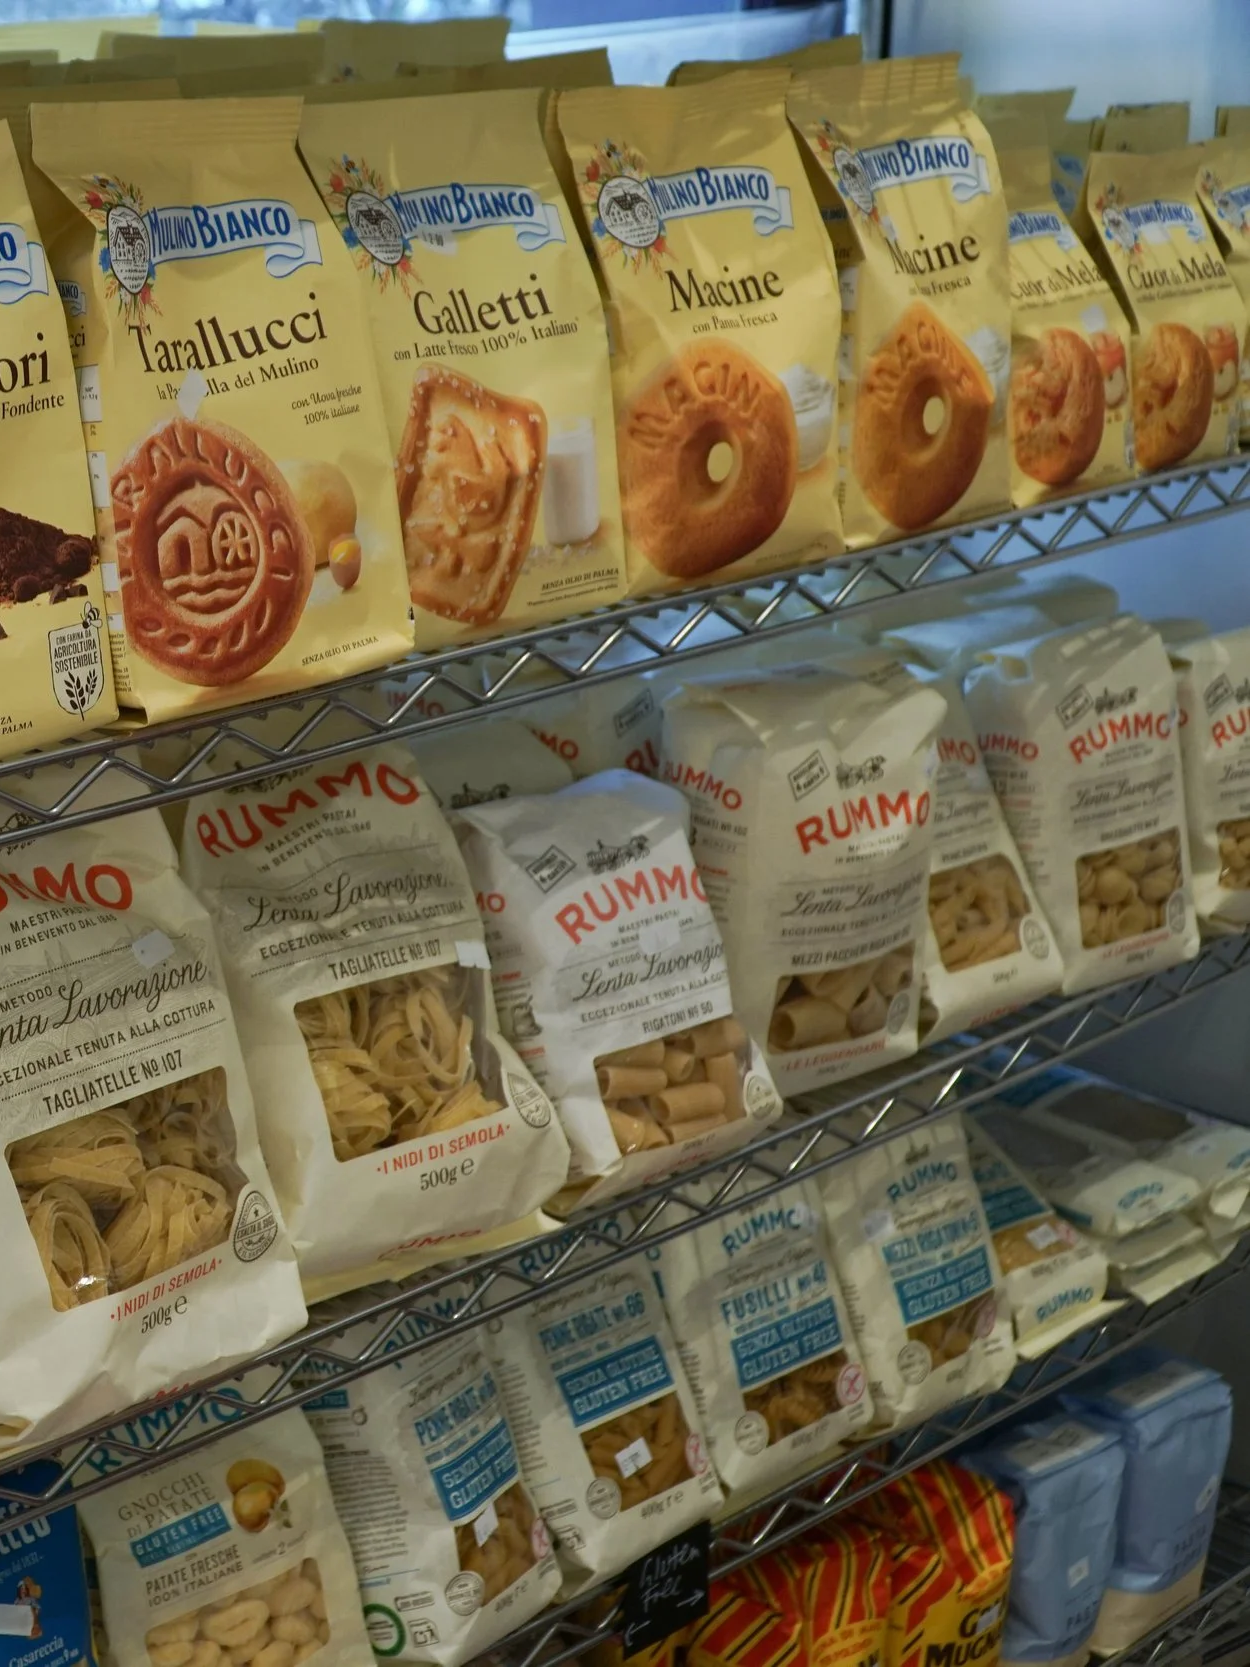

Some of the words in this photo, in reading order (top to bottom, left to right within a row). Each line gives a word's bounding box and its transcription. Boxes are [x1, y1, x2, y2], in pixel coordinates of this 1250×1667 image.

[390, 191, 452, 238] MULINO
[450, 183, 534, 224] BIANCO
[647, 177, 700, 216] MULINO
[698, 167, 770, 205] BIANCO
[886, 233, 980, 276] Macine
[1127, 263, 1170, 291] Cuor
[1180, 252, 1228, 280] Mela
[414, 273, 553, 335] Galletti
[664, 265, 784, 313] Macine
[931, 274, 971, 296] Fresca
[128, 292, 328, 374] Tarallucci
[692, 323, 711, 334] con
[713, 317, 740, 332] Panna
[741, 310, 778, 330] Fresca
[156, 385, 167, 400] la
[234, 373, 256, 389] del
[260, 358, 319, 383] Mulino
[1, 393, 65, 420] Fondente
[304, 410, 329, 425] 100%
[330, 403, 360, 418] italiane
[54, 640, 97, 660] AGRICOLTURA
[54, 652, 99, 674] SOSTENIBILE
[1, 720, 34, 737] PALMA
[197, 762, 420, 858] RUMMO
[265, 821, 320, 855] MAESTRI
[322, 808, 357, 822] PASTAI
[795, 790, 931, 854] RUMMO
[260, 928, 349, 960] ECCEZIONALE
[353, 916, 396, 936] TENUTA
[398, 909, 421, 924] ALLA
[423, 900, 464, 919] COTTURA
[52, 960, 209, 1030] Lavorazione
[573, 970, 638, 1002] Lenta
[75, 1033, 126, 1058] TENUTA
[129, 1020, 161, 1040] ALLA
[163, 999, 216, 1026] COTTURA
[642, 1008, 686, 1034] RIGATONI
[700, 1000, 714, 1015] 50
[383, 1160, 389, 1175] I
[393, 1149, 423, 1171] NIDI
[428, 1144, 445, 1162] DI
[449, 1123, 505, 1155] SEMOLA
[419, 1167, 458, 1191] 500g
[887, 1162, 958, 1203] RUMMO
[141, 1307, 172, 1335] 500g
[721, 1277, 793, 1327] FUSILLI
[1036, 1286, 1094, 1322] RUMMO
[742, 1340, 801, 1381] GLUTEN
[802, 1324, 839, 1355] FREE
[572, 1377, 630, 1416] GLUTEN
[629, 1361, 668, 1391] FREE
[117, 1472, 206, 1521] GNOCCHI
[134, 1522, 188, 1556] GLUTEN
[191, 1508, 223, 1532] FREE
[146, 1568, 187, 1596] PATATE
[190, 1544, 241, 1580] FRESCHE
[9, 1635, 64, 1667] Casareccia
